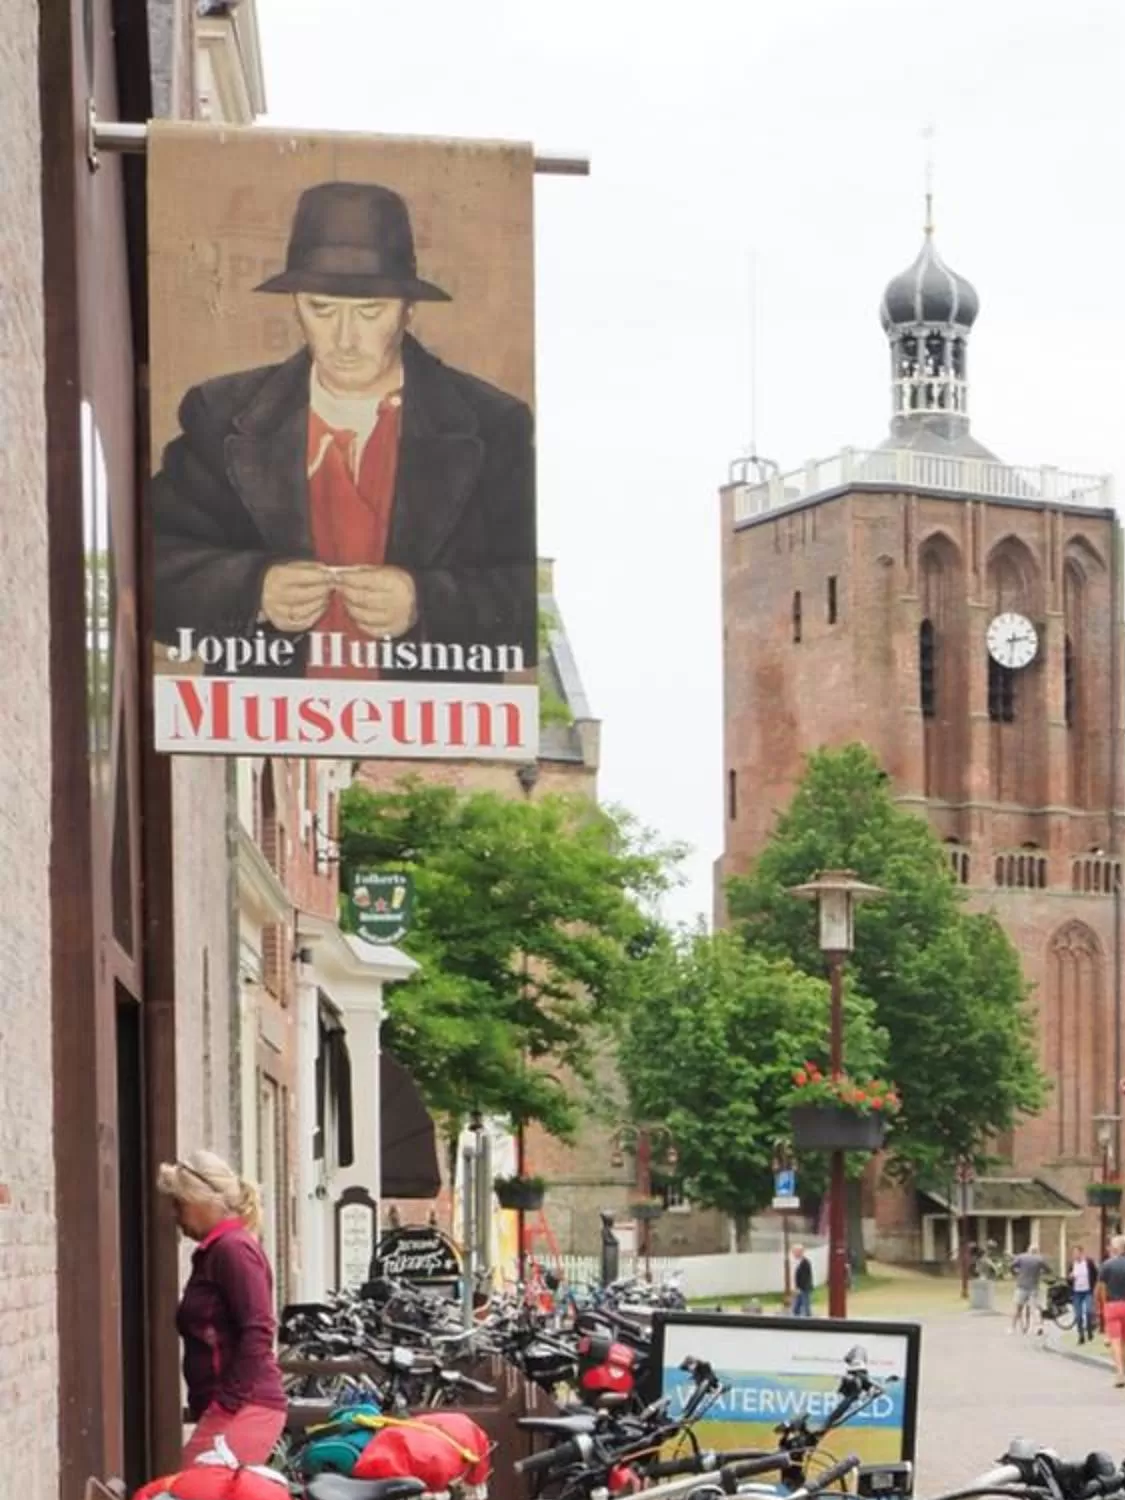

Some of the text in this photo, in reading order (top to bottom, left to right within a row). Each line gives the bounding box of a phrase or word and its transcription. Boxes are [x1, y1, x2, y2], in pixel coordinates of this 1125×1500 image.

[168, 627, 524, 672] Jopie Huisman
[169, 680, 524, 747] Museum
[676, 1384, 894, 1418] WATERWERLD
